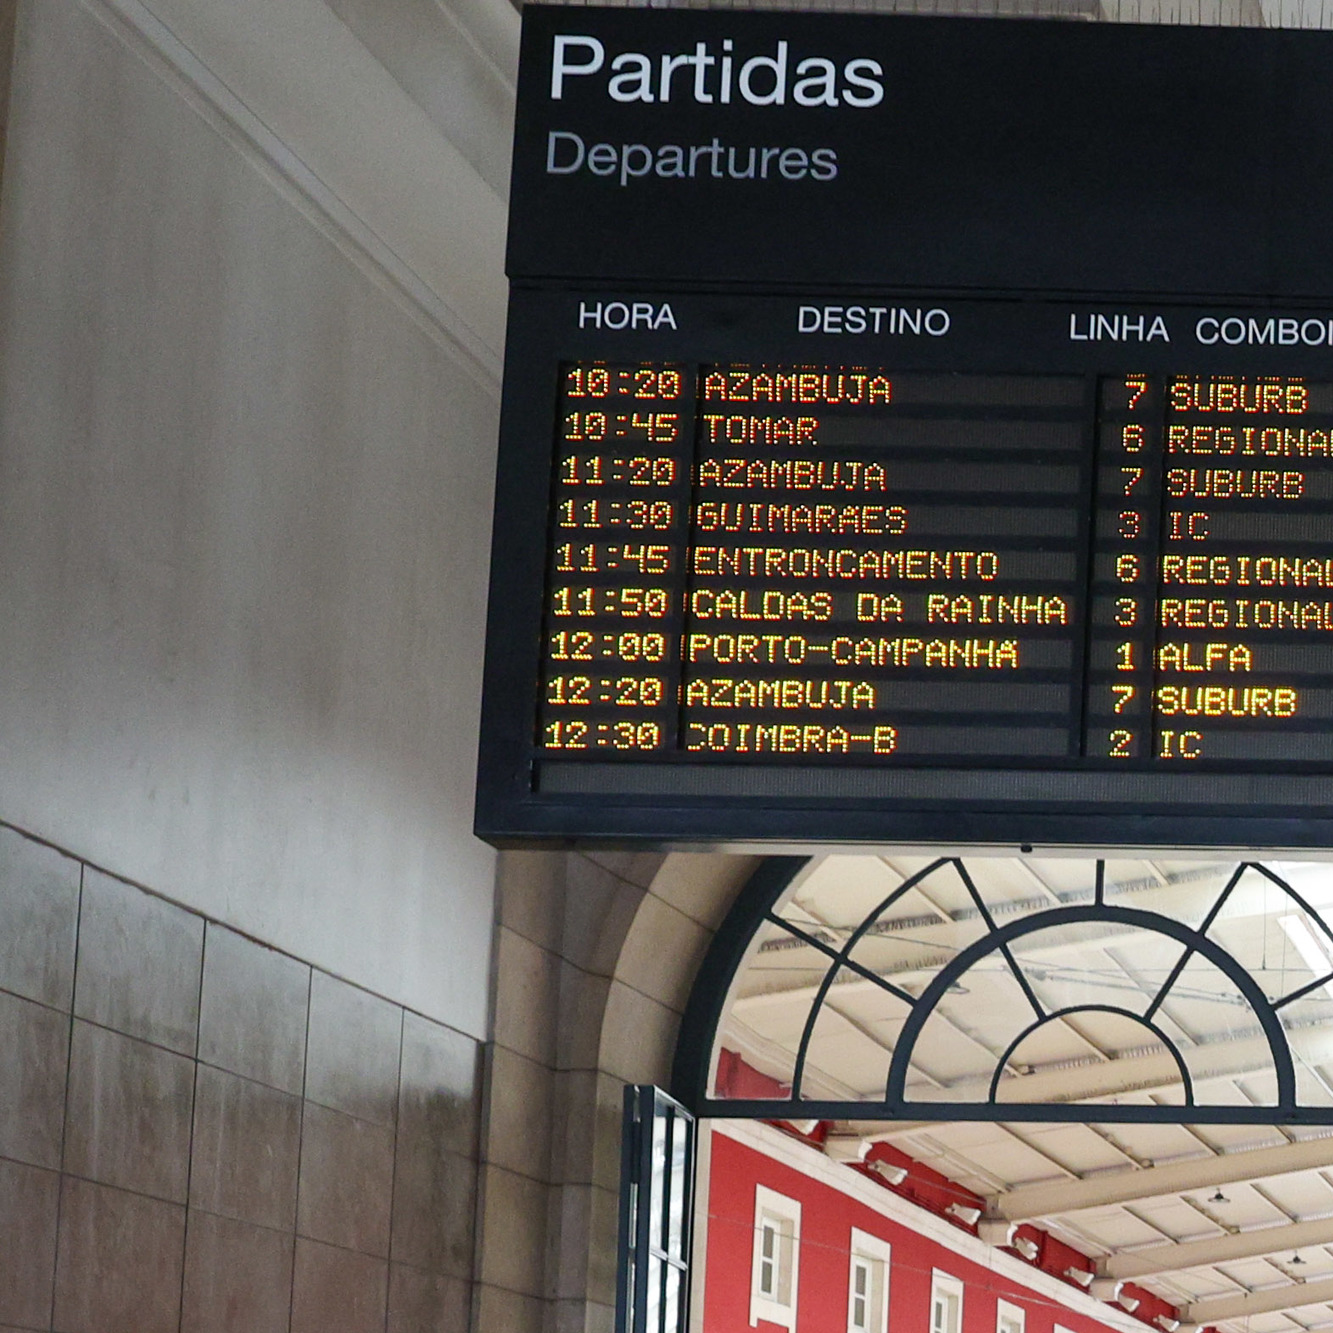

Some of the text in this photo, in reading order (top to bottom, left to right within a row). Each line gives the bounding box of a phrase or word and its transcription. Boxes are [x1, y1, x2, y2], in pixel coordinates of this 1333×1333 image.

[551, 35, 884, 107] Partidas
[547, 131, 837, 186] Departures
[579, 302, 677, 330] HORA
[798, 306, 950, 336] DESTINO
[1070, 314, 1170, 342] LINHA
[568, 369, 681, 399] 10:20
[704, 373, 891, 404] AZAMBUJA
[1171, 384, 1309, 414] SUBURB
[567, 413, 678, 442] 10:45
[703, 415, 819, 444] TOMAR
[564, 457, 676, 485] 11:20
[699, 459, 886, 491] AZAMBUJA
[1168, 469, 1305, 498] SUBURB
[561, 501, 673, 530] 11:30
[1171, 512, 1208, 540] IC
[558, 544, 670, 574] 11:45
[695, 547, 999, 581] ENTRONCAMENTO
[555, 588, 669, 618] 11:50
[692, 590, 833, 621] CALDAS
[858, 593, 904, 622] DA
[928, 595, 1067, 624] RAINHA
[553, 632, 666, 662] 12:00
[1160, 643, 1253, 672] ALFA
[549, 677, 663, 706] 12:20
[688, 679, 876, 709] AZAMBUJA
[1158, 686, 1298, 718] SUBURB
[546, 721, 660, 750] 12:30
[1160, 731, 1203, 759] IC
